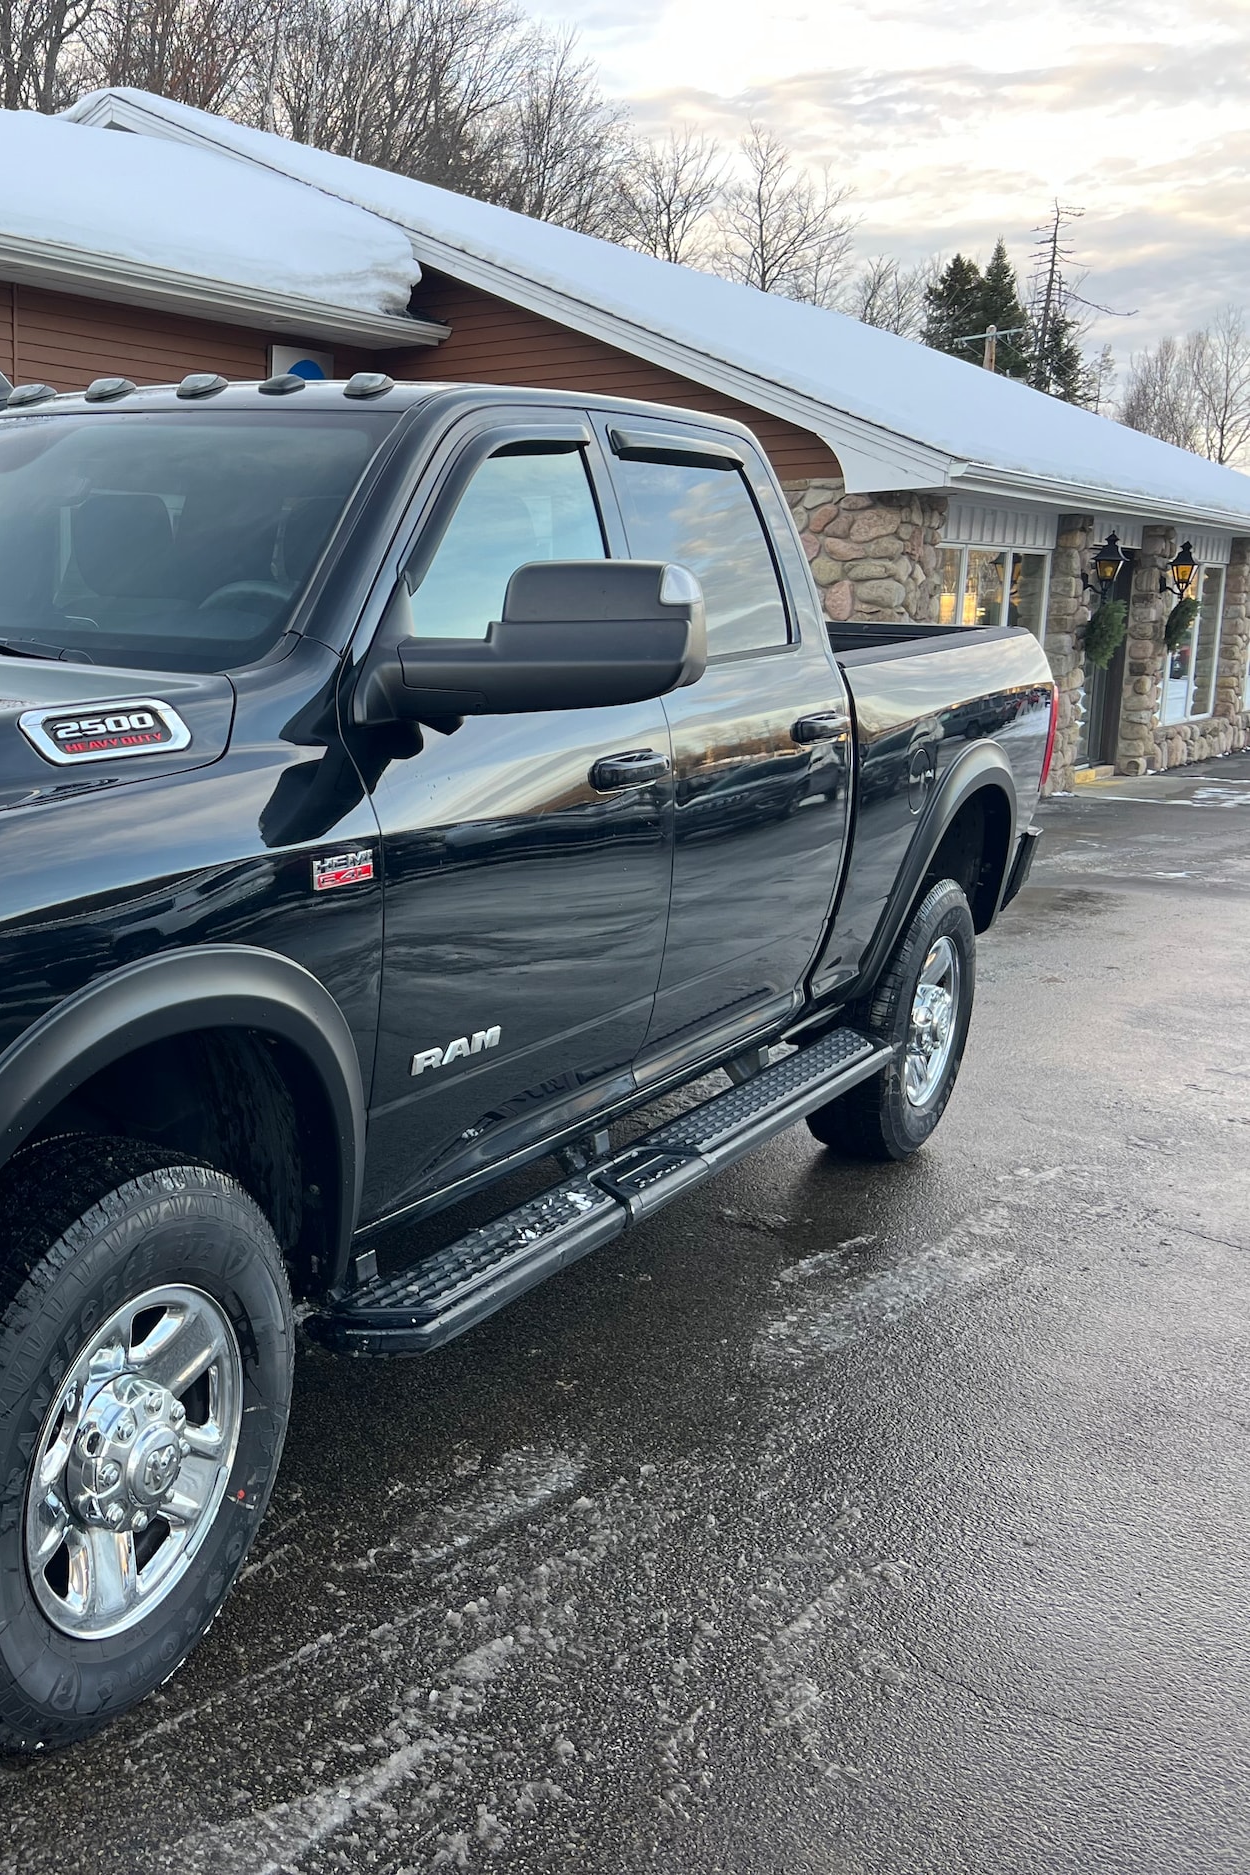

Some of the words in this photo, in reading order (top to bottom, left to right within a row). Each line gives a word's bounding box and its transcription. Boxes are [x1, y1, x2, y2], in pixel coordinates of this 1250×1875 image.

[53, 712, 154, 739] 2500
[65, 738, 120, 753] HEAVY
[121, 732, 163, 745] DUTY
[312, 849, 373, 876] HEMI
[411, 1025, 502, 1077] RAM
